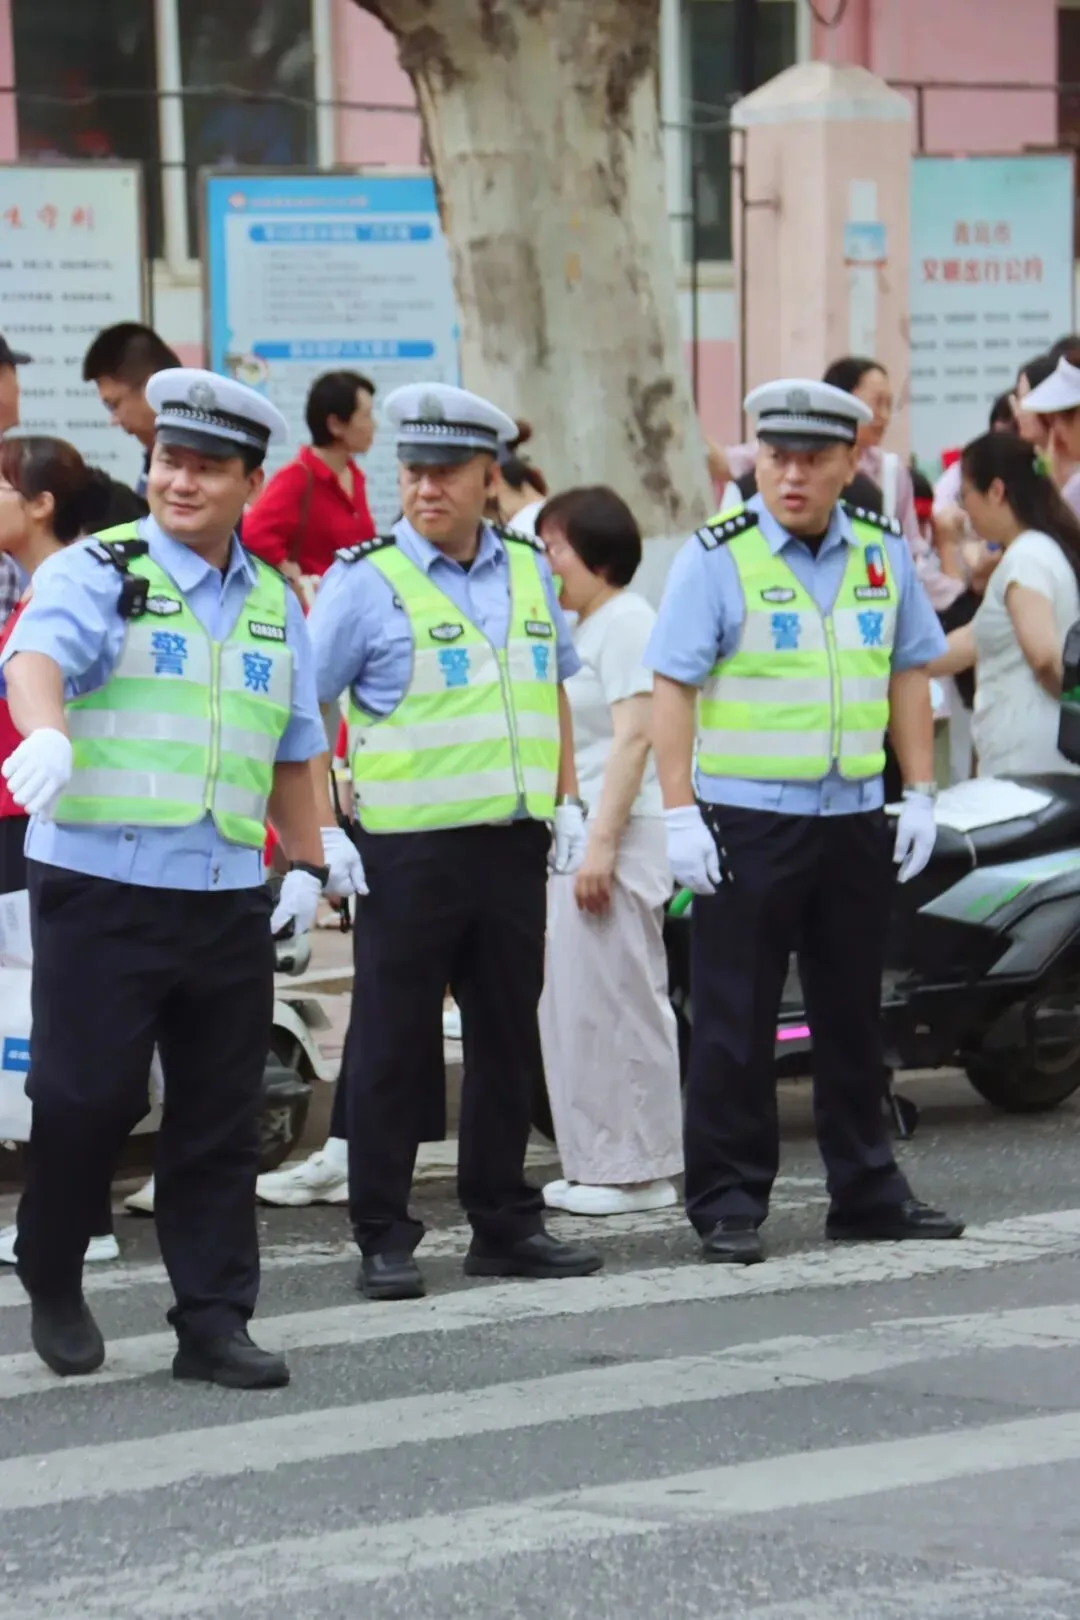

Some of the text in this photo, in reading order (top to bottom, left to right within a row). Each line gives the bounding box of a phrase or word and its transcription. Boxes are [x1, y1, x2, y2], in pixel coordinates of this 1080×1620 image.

[771, 609, 884, 650] 警 察
[150, 630, 273, 693] 警 察
[438, 647, 469, 687] 警
